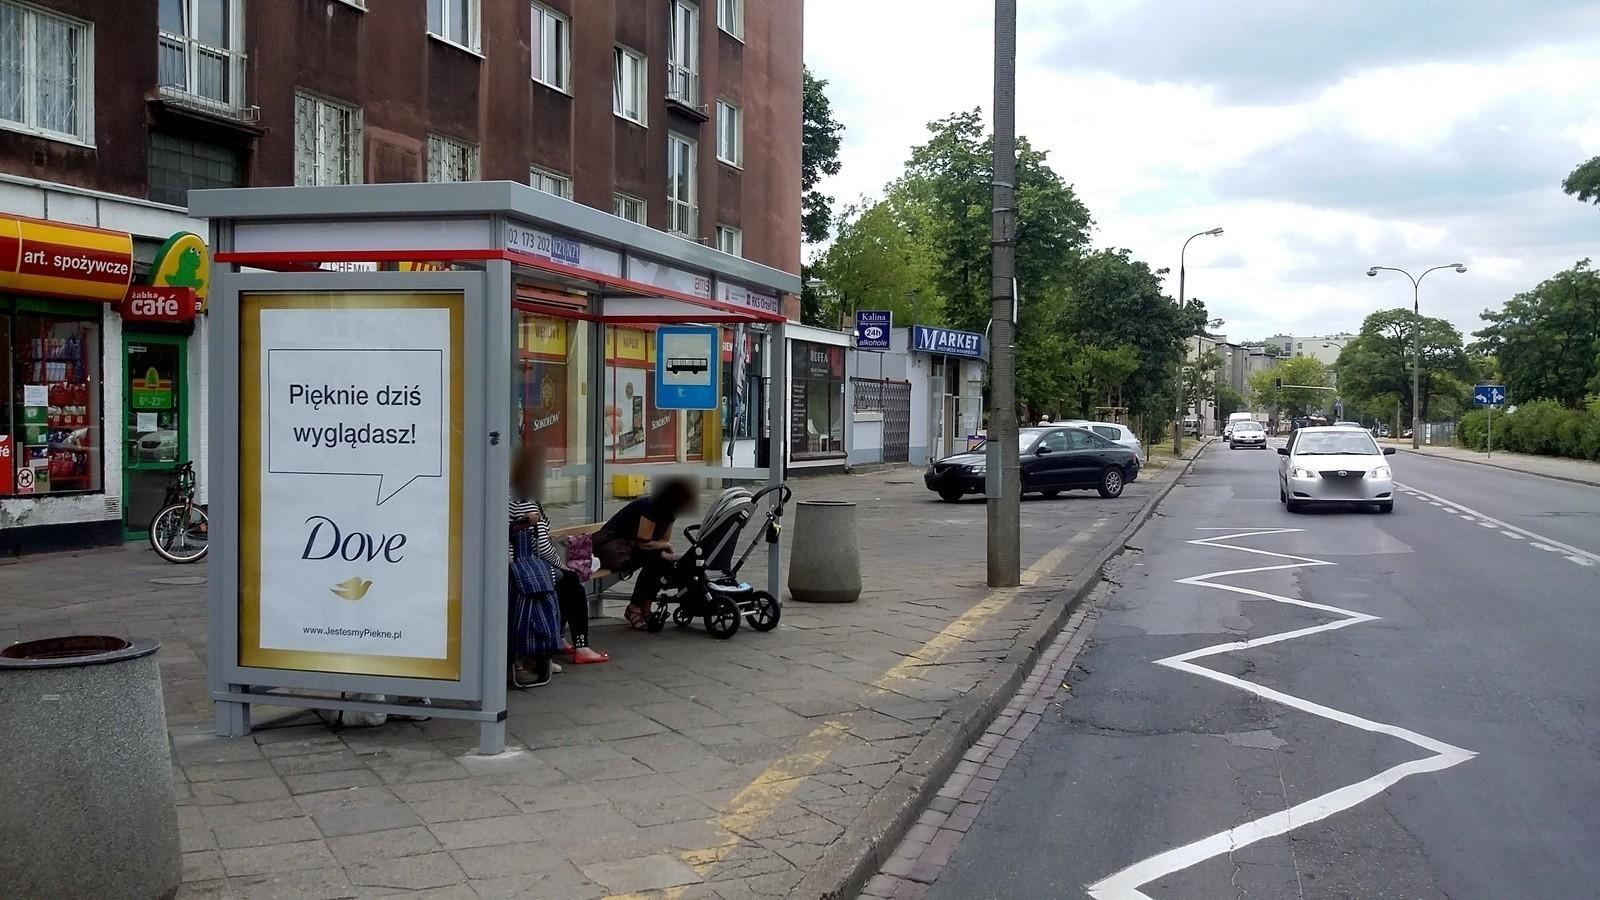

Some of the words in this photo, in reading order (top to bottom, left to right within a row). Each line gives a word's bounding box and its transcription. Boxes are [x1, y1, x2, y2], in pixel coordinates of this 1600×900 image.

[522, 232, 534, 248] 173
[537, 235, 550, 252] 202
[552, 239, 565, 255] N21
[24, 251, 48, 265] art.
[54, 255, 129, 275] spożywcze
[695, 277, 710, 292] ams
[131, 294, 178, 316] café
[862, 313, 886, 321] Kalina
[859, 339, 887, 347] alkohole
[866, 329, 881, 337] 24h
[918, 328, 979, 350] MARKET
[289, 384, 369, 411] Pięknie
[376, 384, 422, 406] dziś
[293, 423, 416, 449] wyglądasz!
[301, 515, 407, 564] Dove
[303, 626, 402, 640] www.JestesmyPiekne.pl
